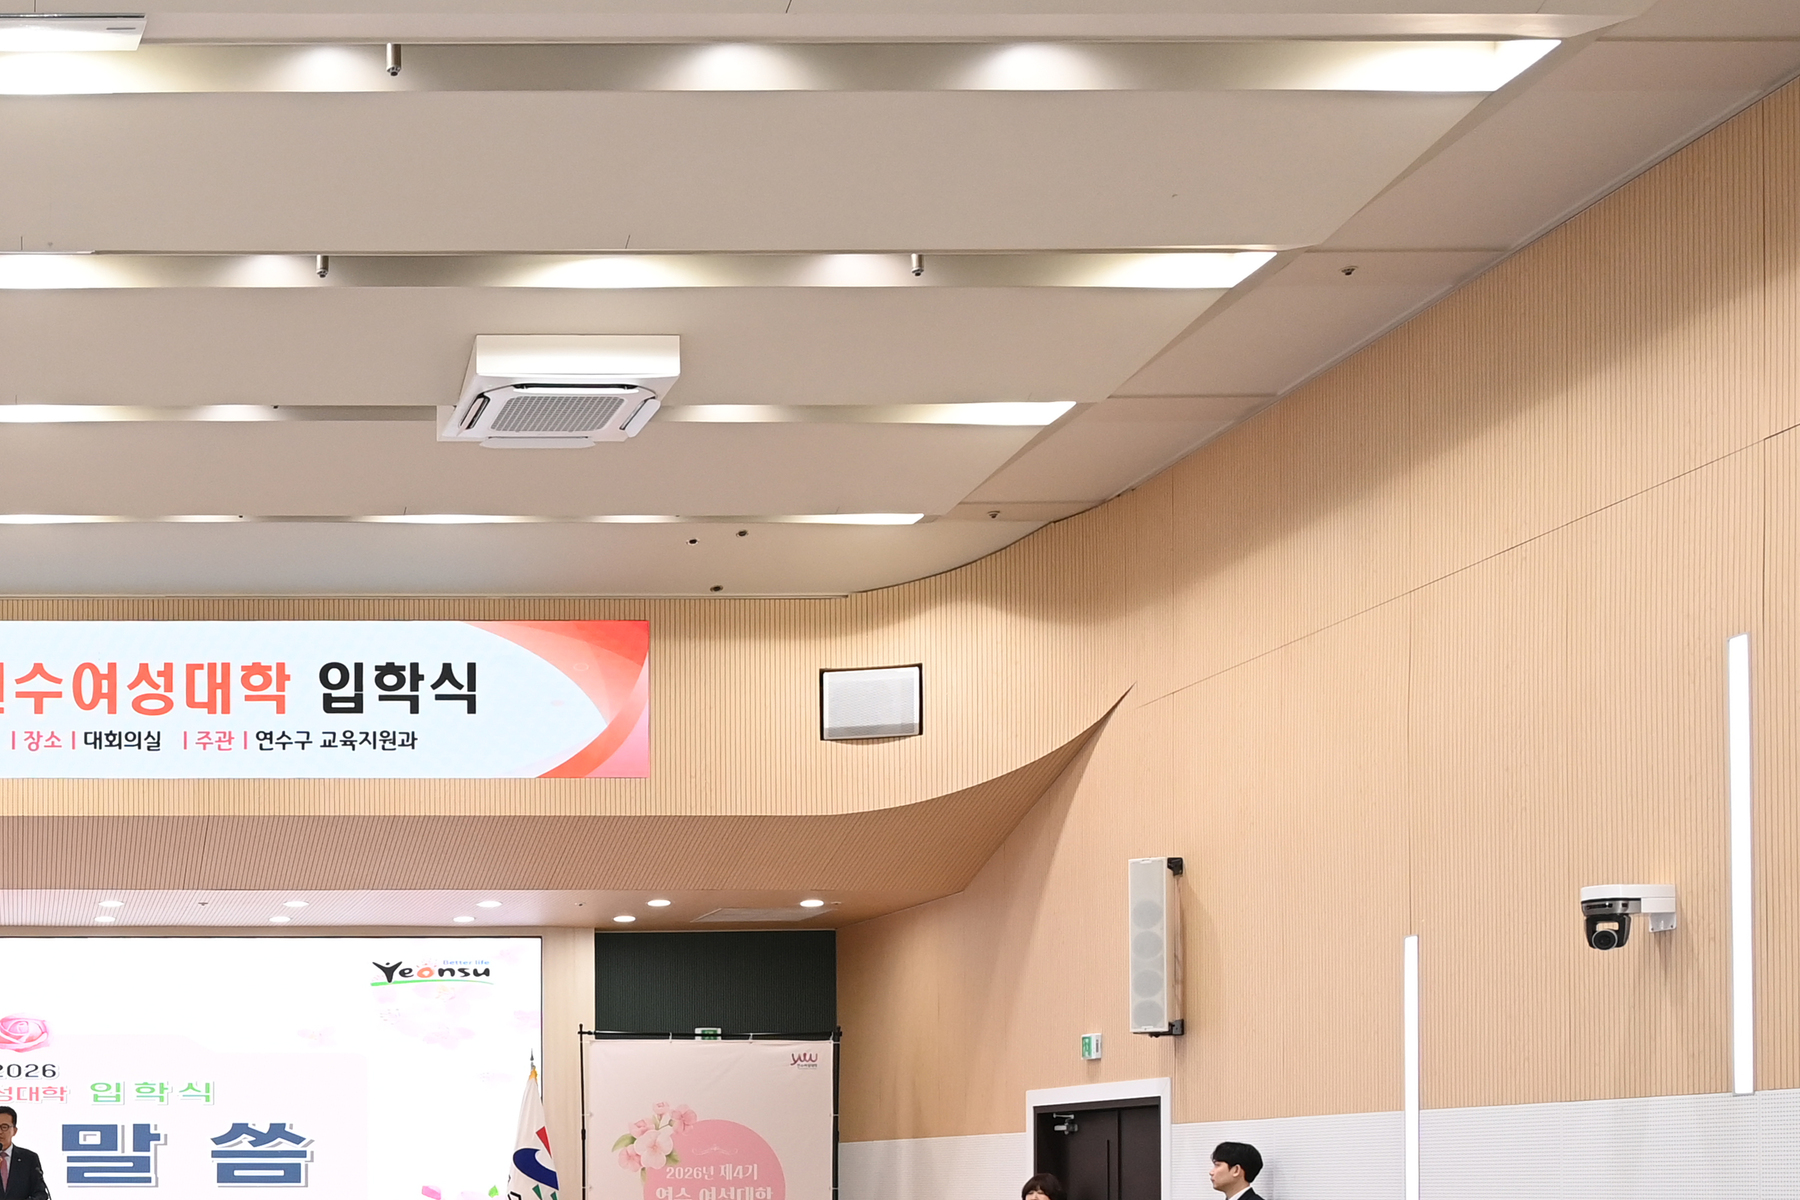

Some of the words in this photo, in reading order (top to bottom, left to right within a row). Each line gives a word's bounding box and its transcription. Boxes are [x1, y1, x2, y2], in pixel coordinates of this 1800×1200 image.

[318, 661, 477, 715] 입학식
[24, 730, 63, 752] 장소
[83, 729, 161, 752] 대회의실
[195, 730, 235, 752] 주관
[255, 730, 313, 752] 연수구
[319, 729, 419, 752] 교육지원과
[371, 960, 491, 984] Yeonsu
[90, 1081, 212, 1104] 입학식
[666, 1165, 715, 1180] 2026년
[719, 1163, 758, 1180] 제4기
